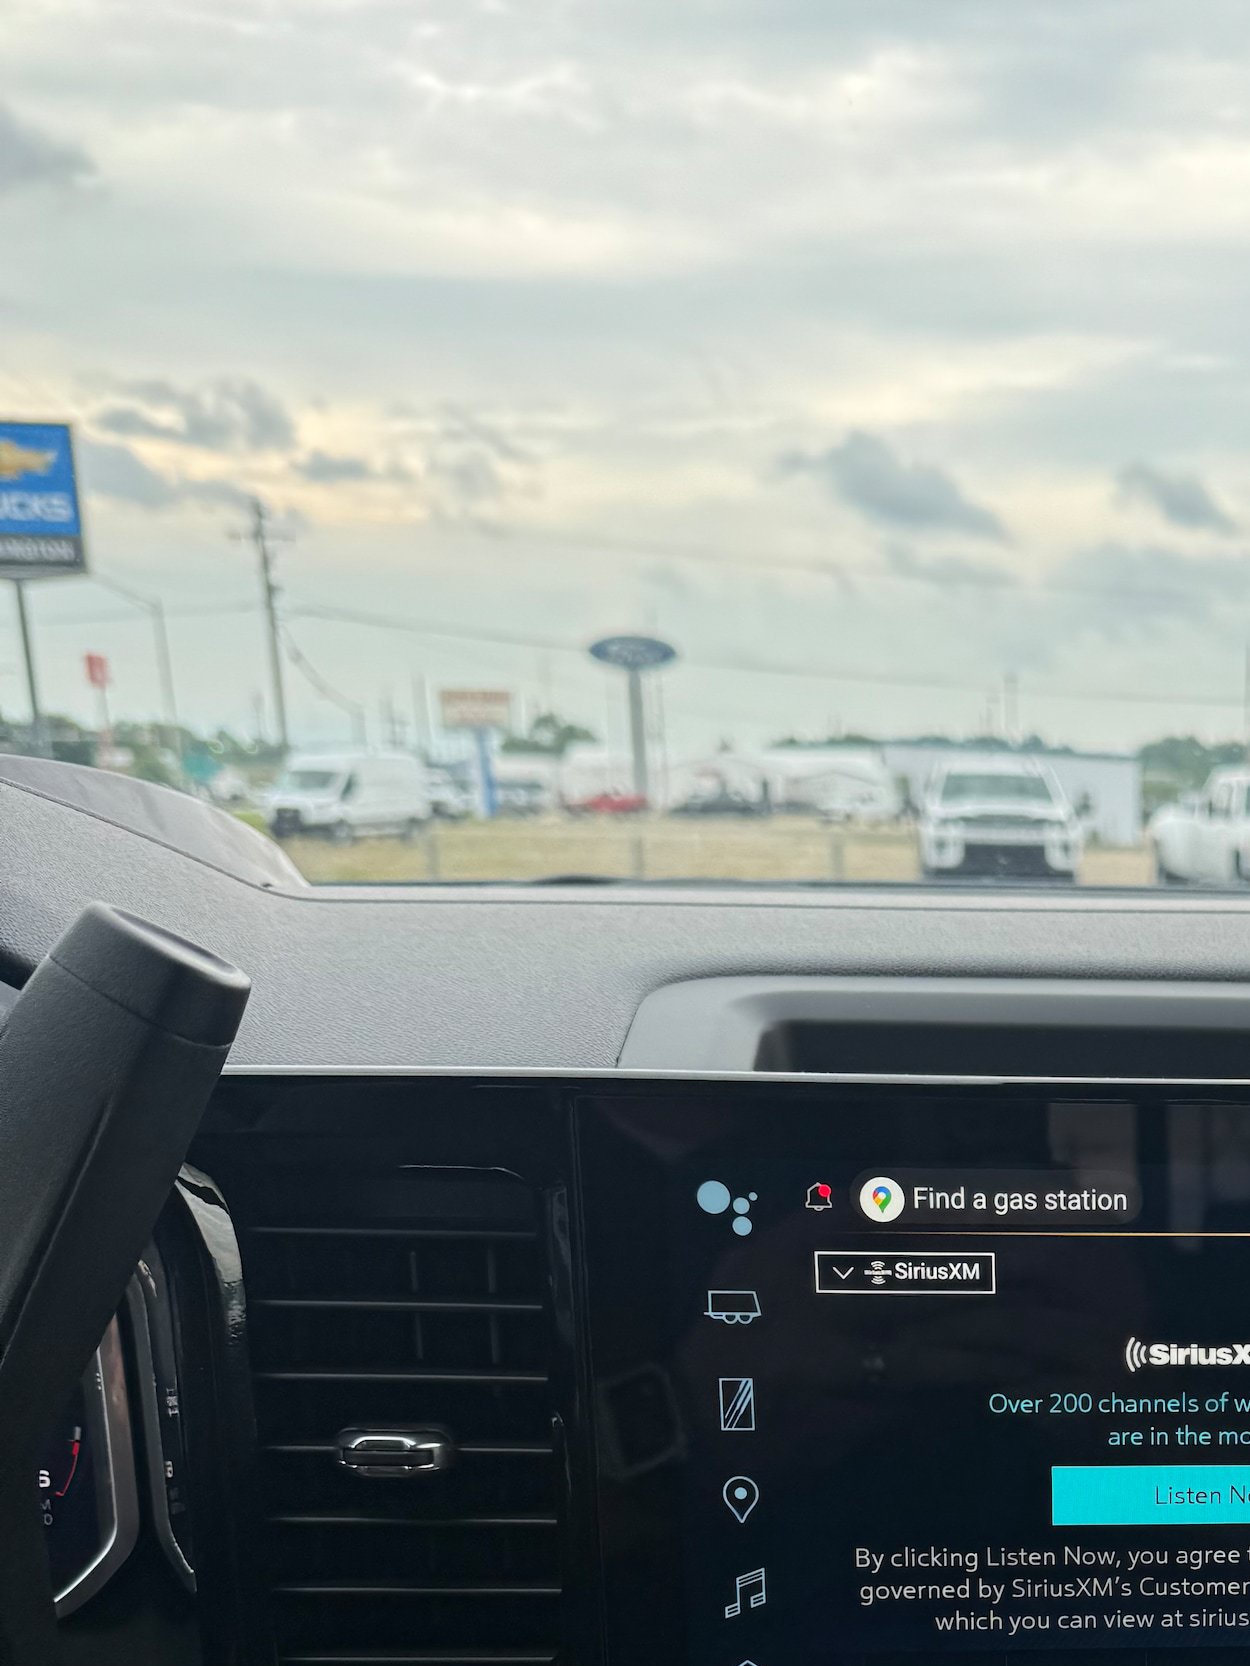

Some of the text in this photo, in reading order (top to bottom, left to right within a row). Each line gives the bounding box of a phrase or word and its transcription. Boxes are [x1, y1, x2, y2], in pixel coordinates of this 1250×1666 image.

[914, 1187, 1127, 1215] Find a gas station
[894, 1262, 981, 1280] SiriusXM
[989, 1394, 1044, 1414] Over
[1050, 1393, 1093, 1414] 200
[1099, 1392, 1200, 1413] channels
[1205, 1392, 1230, 1413] of
[1108, 1431, 1144, 1446] are
[1150, 1427, 1169, 1446] in
[1176, 1425, 1212, 1446] the
[1156, 1486, 1221, 1505] Listen
[856, 1548, 885, 1573] By
[891, 1548, 979, 1570] clicking
[987, 1547, 1056, 1567] Listen
[1065, 1546, 1121, 1569] Now,
[1128, 1550, 1168, 1570] you
[1176, 1549, 1241, 1570] agree
[859, 1578, 970, 1606] governed
[978, 1578, 1005, 1604] by
[1140, 1576, 1250, 1597] Customer
[934, 1609, 1003, 1632] which
[1009, 1615, 1051, 1635] you
[1057, 1613, 1098, 1630] can
[1104, 1609, 1155, 1629] view
[1161, 1609, 1184, 1629] at
